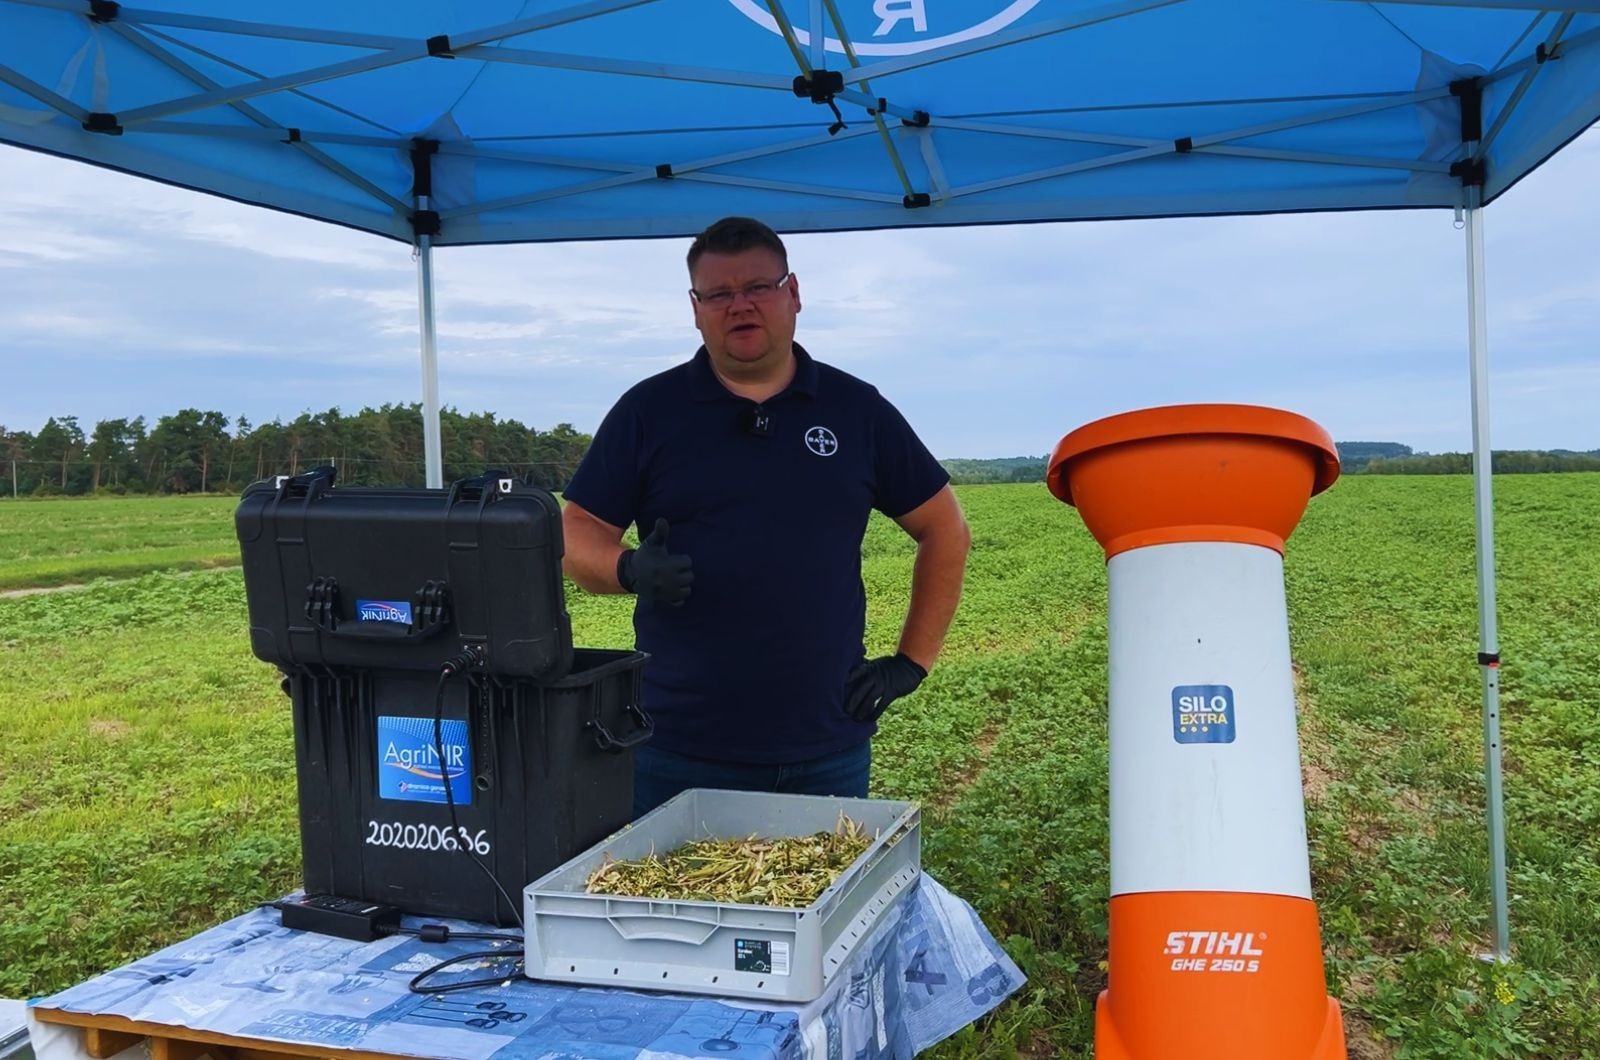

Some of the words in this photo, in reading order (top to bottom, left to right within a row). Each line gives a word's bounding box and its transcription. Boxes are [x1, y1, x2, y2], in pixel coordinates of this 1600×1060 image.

[1179, 695, 1227, 712] SILO
[1180, 713, 1228, 725] EXTRA
[383, 741, 464, 769] AgriNIR
[366, 821, 490, 855] 202020636
[1163, 931, 1263, 956] STIHL
[1170, 959, 1207, 971] GHE
[1209, 959, 1245, 972] 250
[1246, 960, 1260, 973] S
